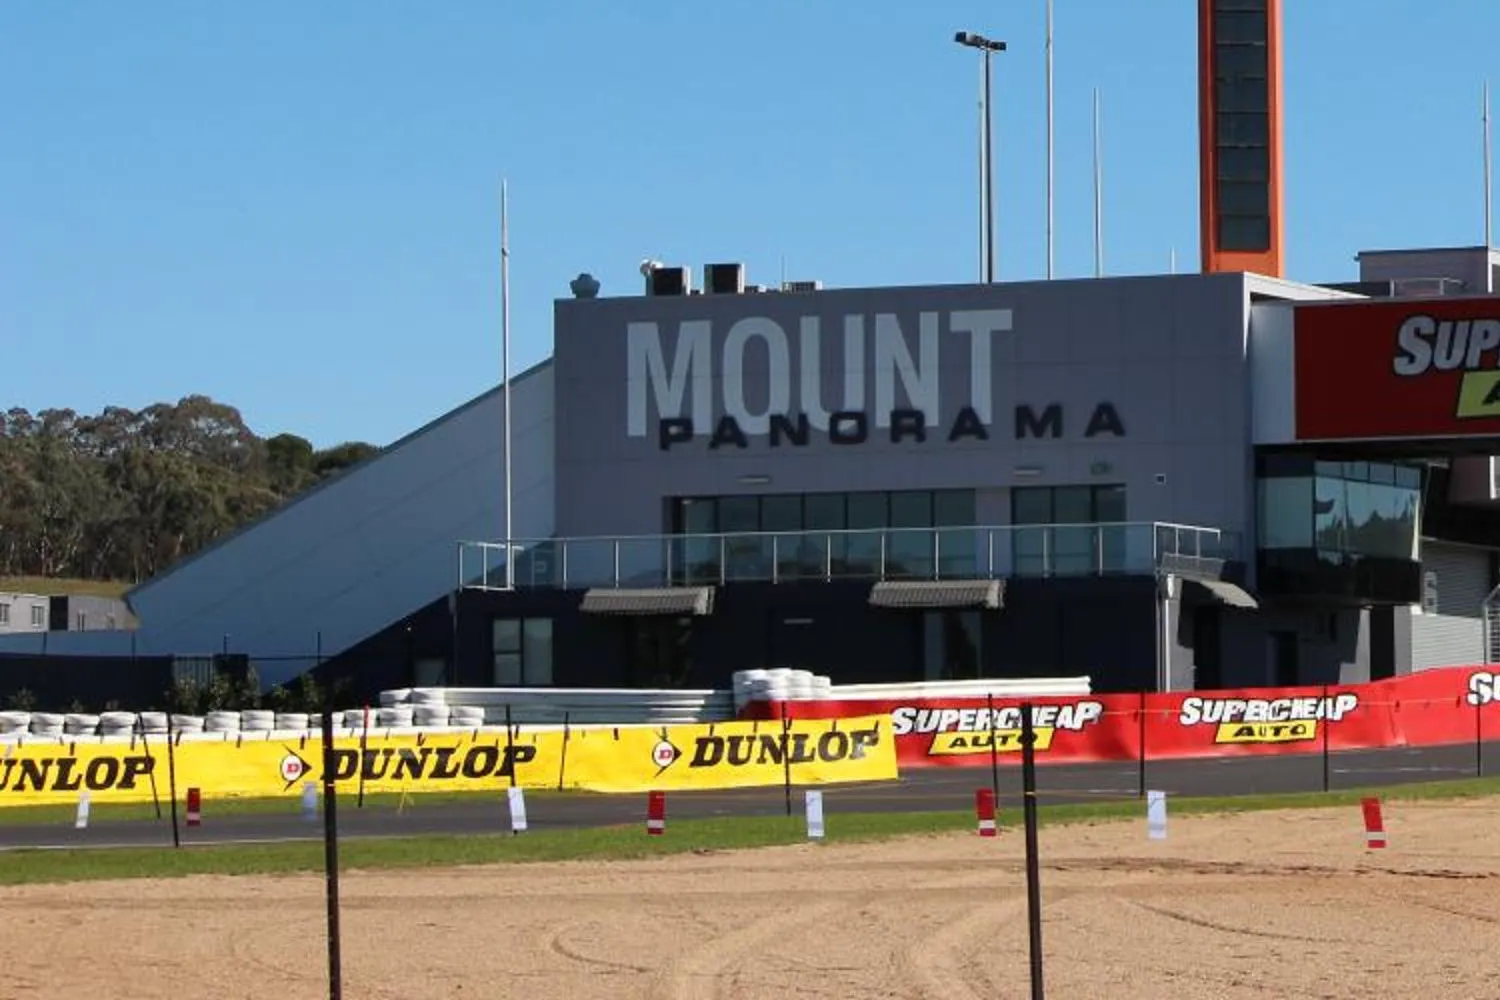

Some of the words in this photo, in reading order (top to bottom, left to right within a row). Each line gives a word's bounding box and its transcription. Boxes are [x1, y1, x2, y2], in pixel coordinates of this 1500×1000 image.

[627, 309, 1012, 437] MOUNT
[659, 402, 1126, 450] PANORAMA
[689, 730, 880, 768] DUNLOP
[1232, 723, 1307, 737] AUTO
[320, 745, 537, 780] DUNLOP
